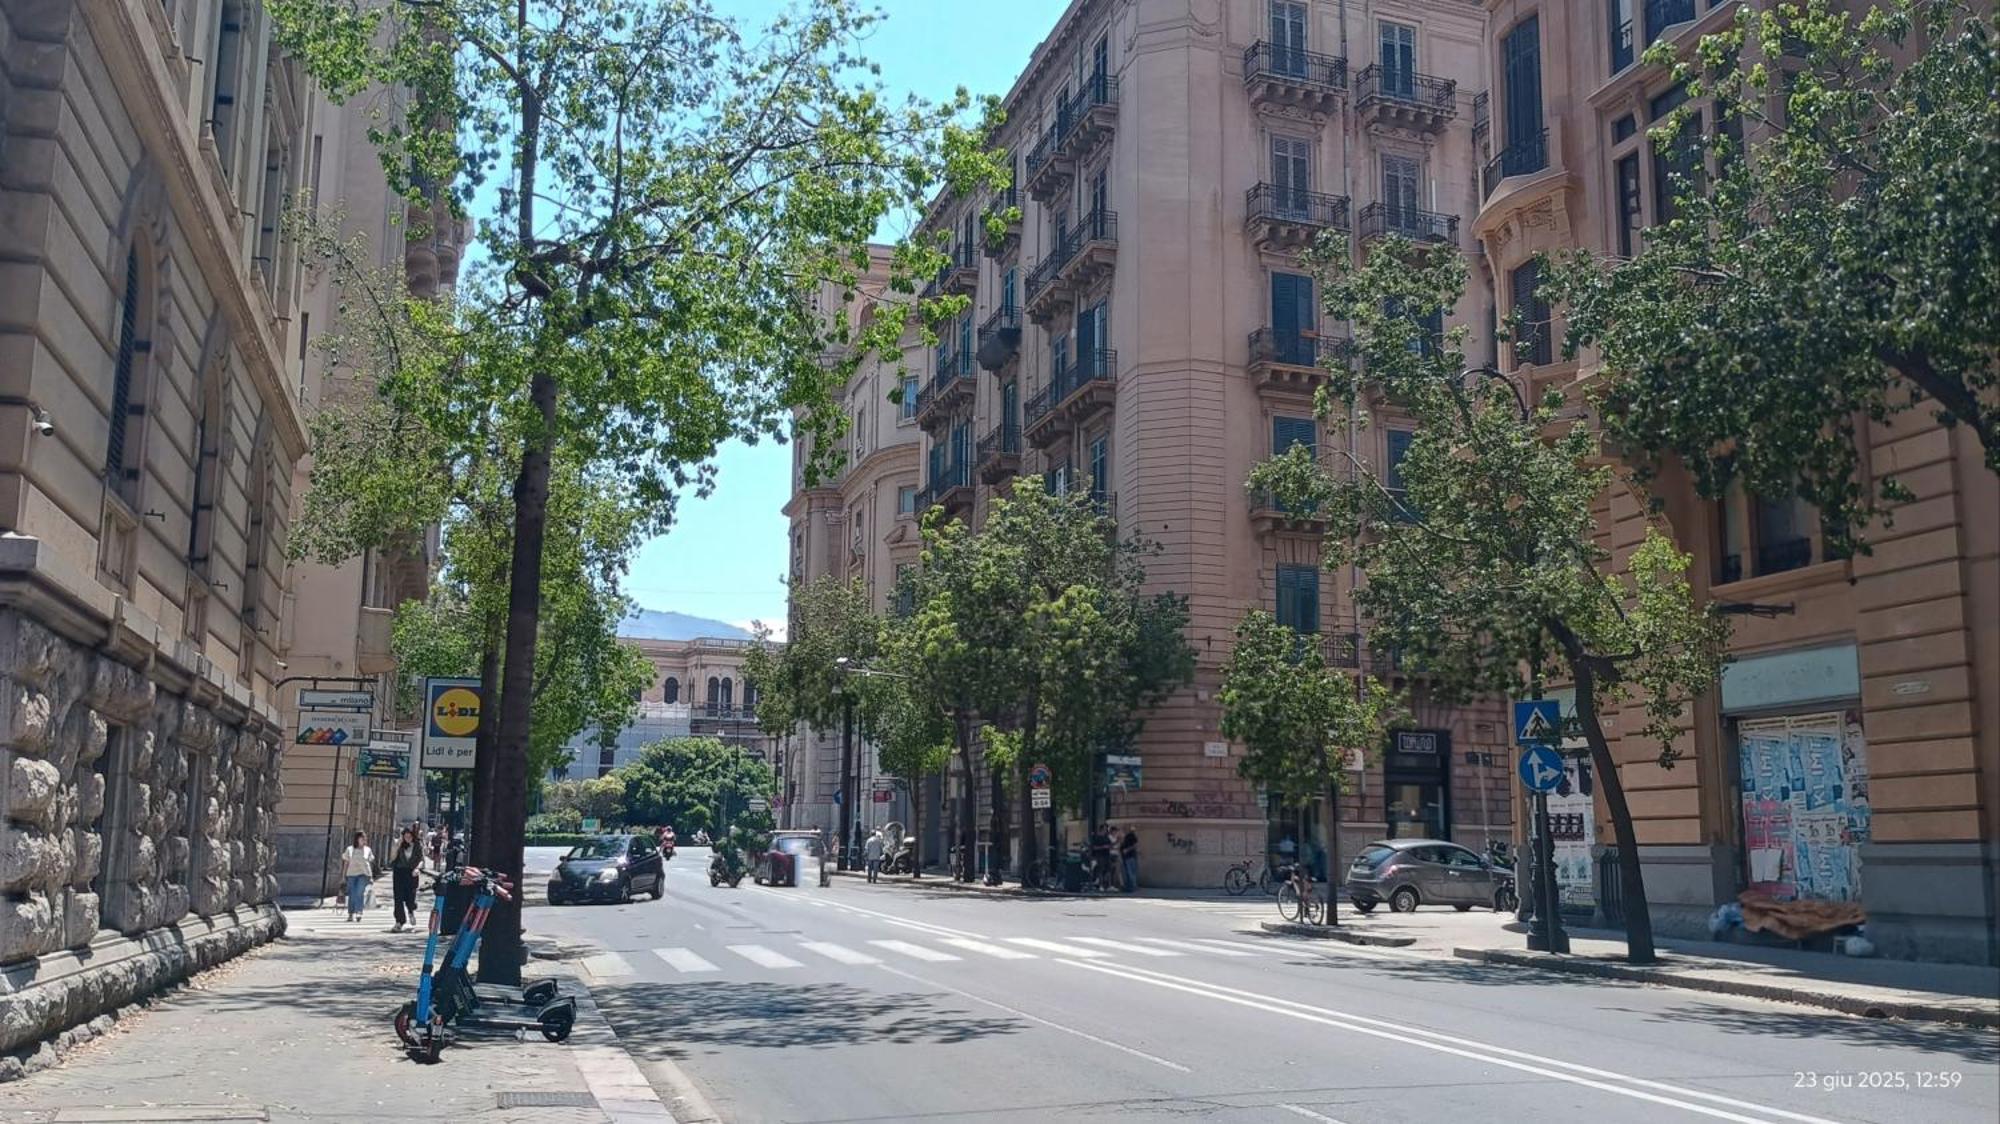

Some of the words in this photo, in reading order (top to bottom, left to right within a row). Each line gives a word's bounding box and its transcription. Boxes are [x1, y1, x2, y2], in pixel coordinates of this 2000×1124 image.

[426, 746, 445, 756] Lidl
[447, 746, 454, 756] è
[457, 749, 473, 757] per
